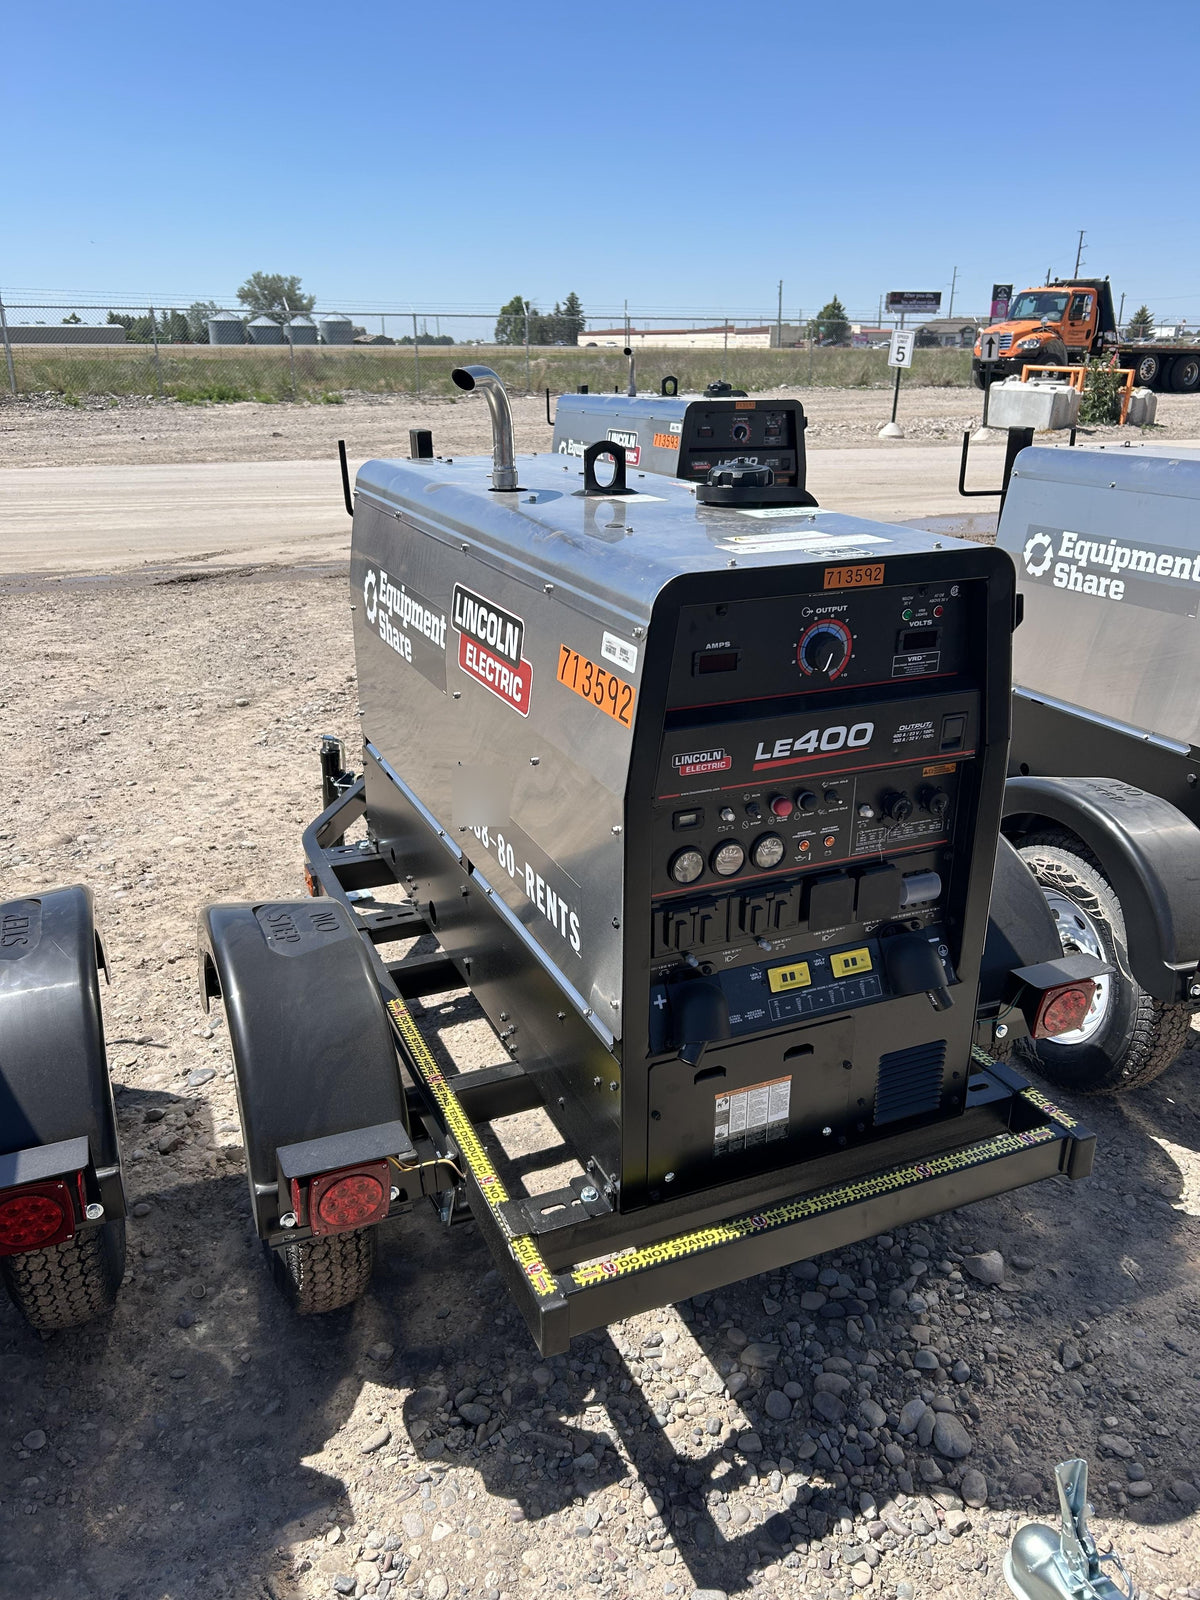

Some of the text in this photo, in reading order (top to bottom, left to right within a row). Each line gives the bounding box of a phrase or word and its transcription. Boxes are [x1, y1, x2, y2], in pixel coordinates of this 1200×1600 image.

[896, 346, 905, 362] 5
[654, 433, 679, 449] 713593
[1057, 531, 1200, 582] Equipment
[826, 567, 882, 585] 713592
[1053, 562, 1125, 600] Share
[379, 569, 447, 650] Equipment
[816, 605, 848, 614] OUTPUT
[909, 619, 932, 627] VOLTS
[378, 609, 412, 663] Share
[455, 592, 520, 661] LINCOLN
[705, 641, 731, 650] AMPS
[465, 642, 522, 703] ELECTRIC
[561, 645, 632, 724] 713592
[754, 721, 875, 761] LE400
[675, 751, 722, 766] LINCOLN
[685, 761, 726, 773] ELECTRIC
[1, 914, 29, 947] STEP
[266, 913, 301, 943] STEP
[309, 912, 340, 932] NO
[400, 1016, 436, 1076] DO NOT STAND HERE
[435, 1083, 488, 1175] NE PAS TENEZ DEBOUT ICI
[930, 1161, 949, 1172] NO
[949, 1155, 965, 1166] SE
[966, 1147, 994, 1161] PARE
[488, 1186, 500, 1200] NO
[768, 1171, 917, 1222] NE PAS TENEZ DEBOUT ICI
[619, 1222, 752, 1268] DO NOT STAND HERE
